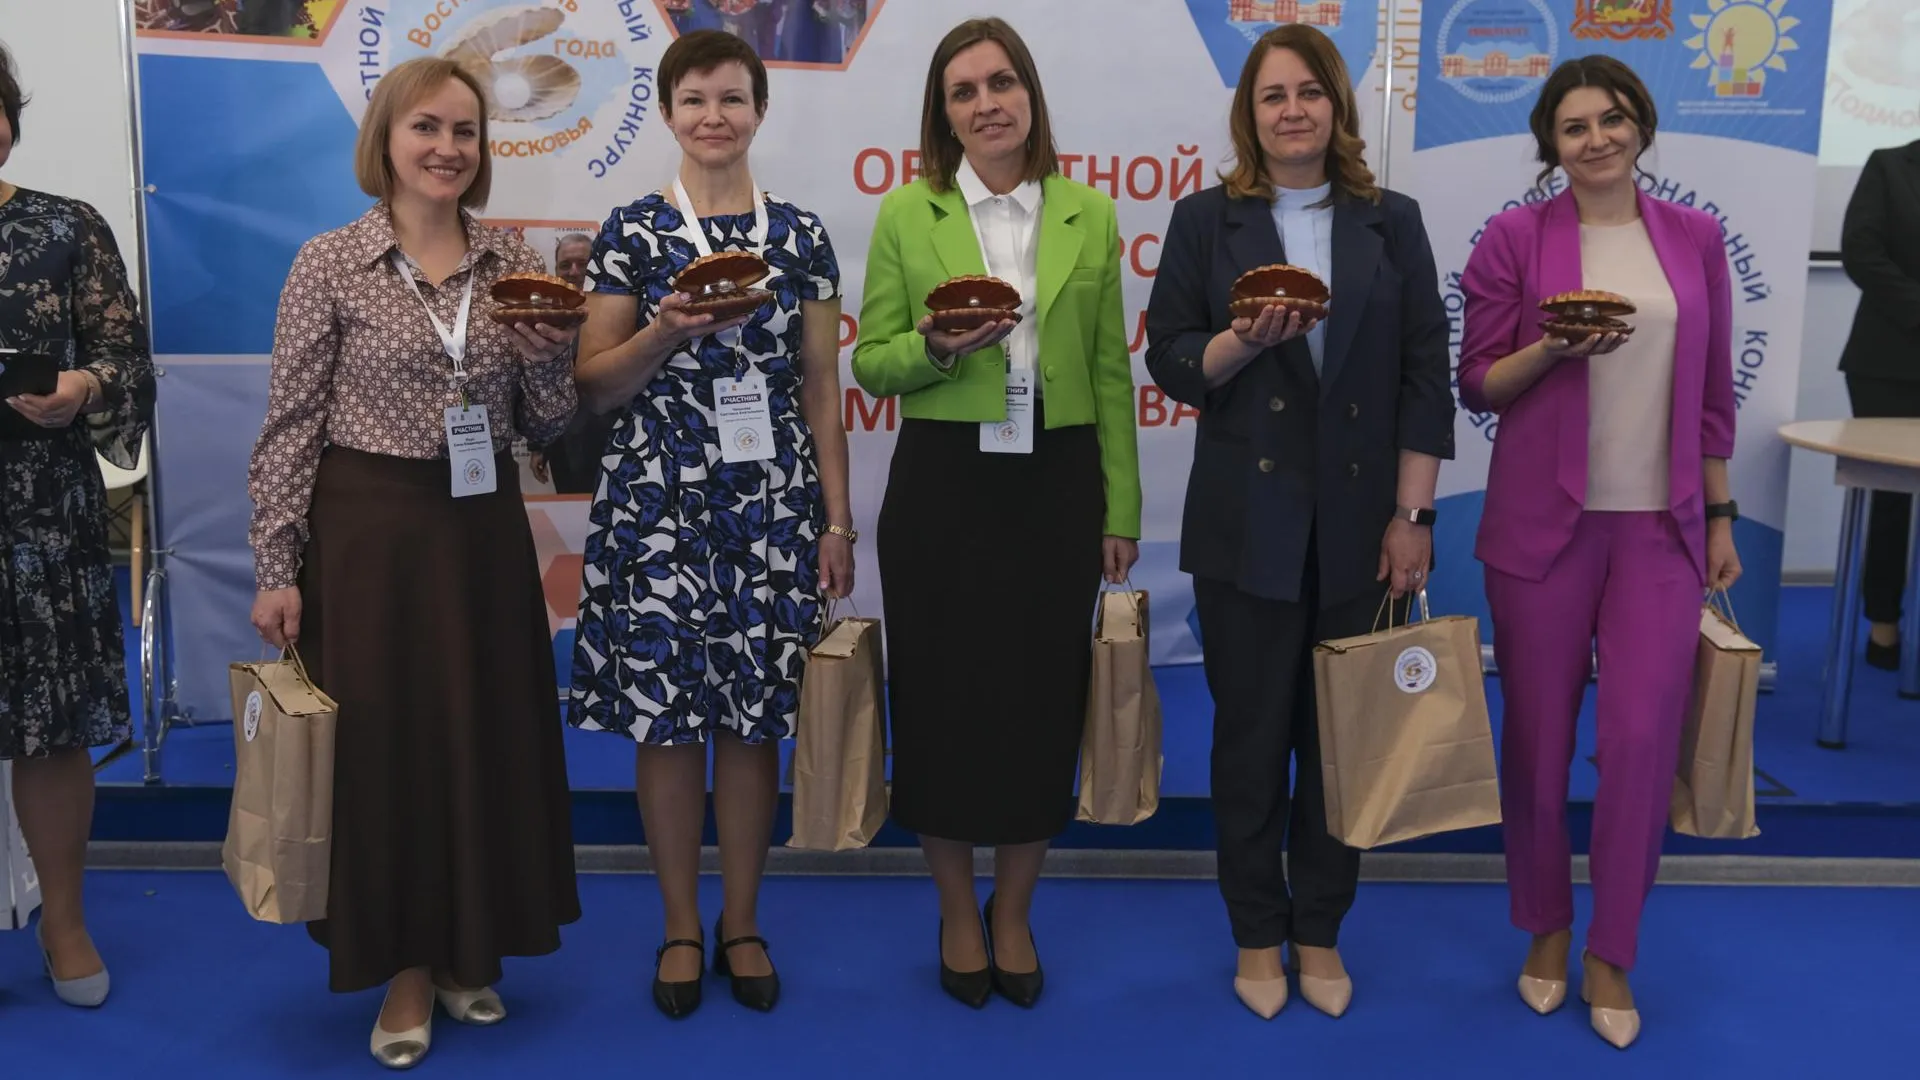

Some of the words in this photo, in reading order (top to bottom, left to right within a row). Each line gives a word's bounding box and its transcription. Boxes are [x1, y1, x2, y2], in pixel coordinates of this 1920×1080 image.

[554, 38, 616, 58] года
[588, 66, 653, 178] КОНКУРС
[722, 395, 759, 404] УЧАСТНИК
[452, 424, 483, 435] УЧАСТНИК
